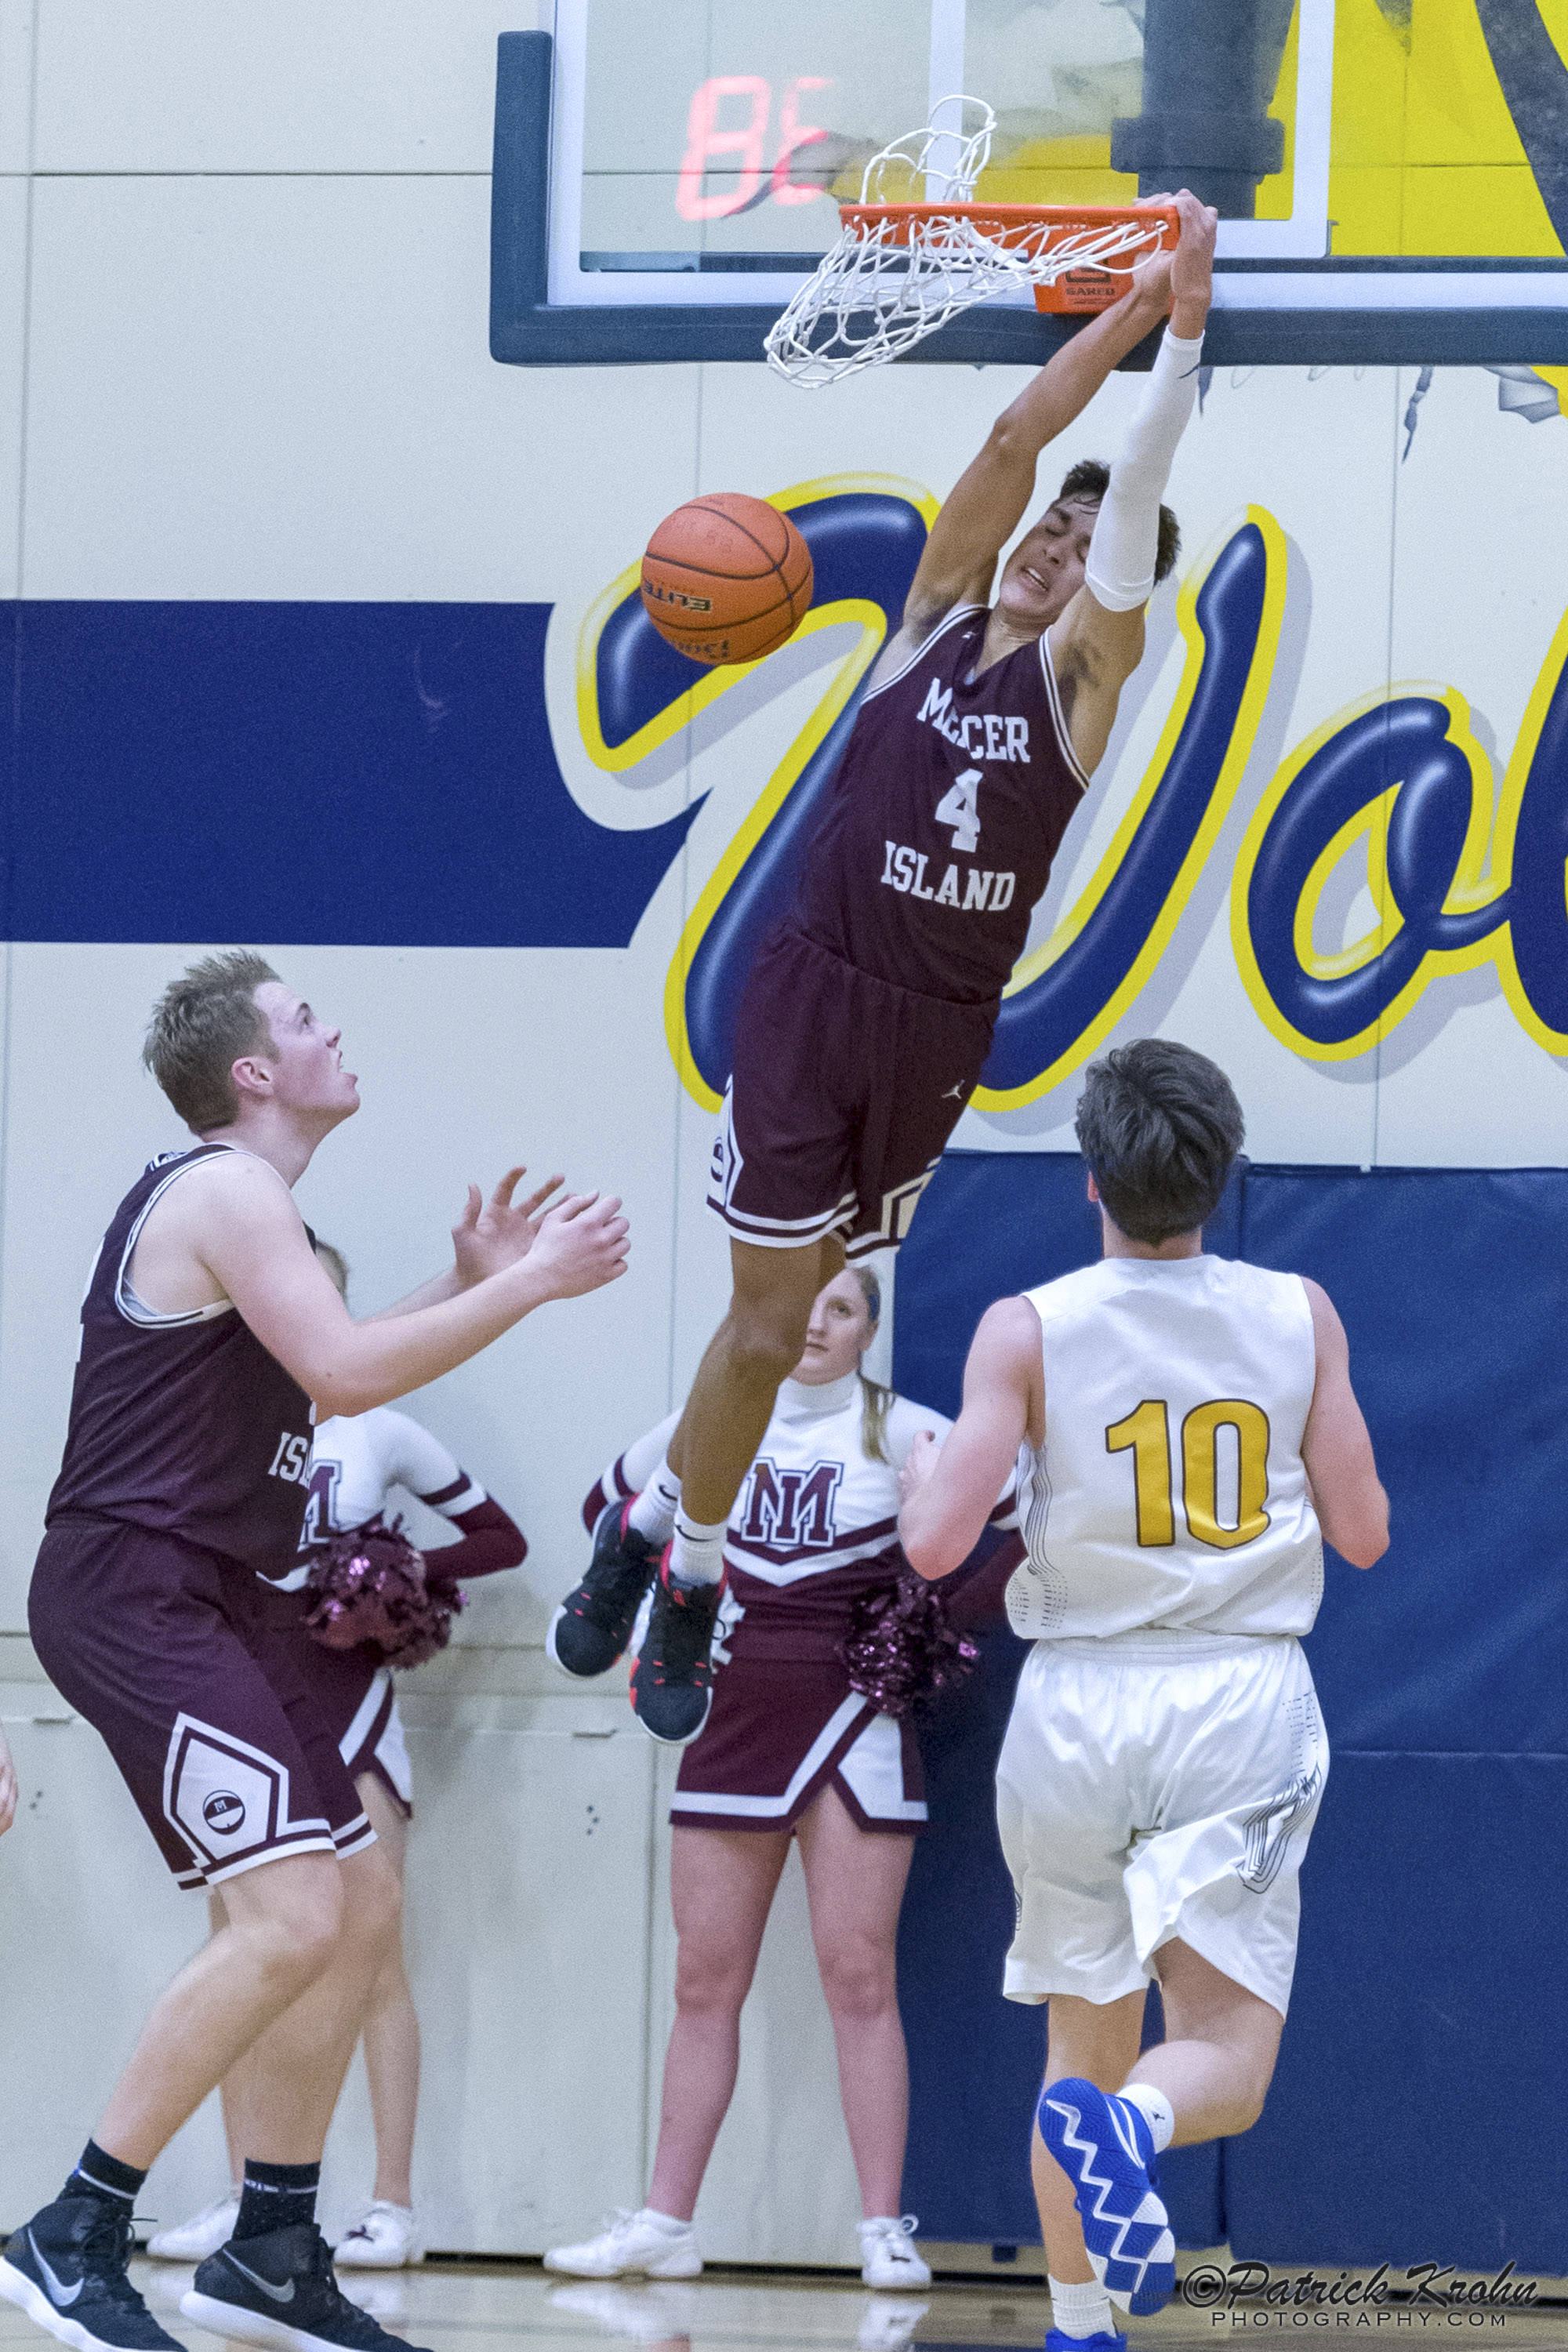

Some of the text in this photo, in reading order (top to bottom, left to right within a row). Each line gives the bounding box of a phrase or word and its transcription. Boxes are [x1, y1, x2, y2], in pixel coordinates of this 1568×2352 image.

[643, 579, 713, 613] ELITE
[935, 768, 984, 853] 4
[880, 840, 1016, 912] ISLAND
[1105, 1398, 1272, 1551] 10
